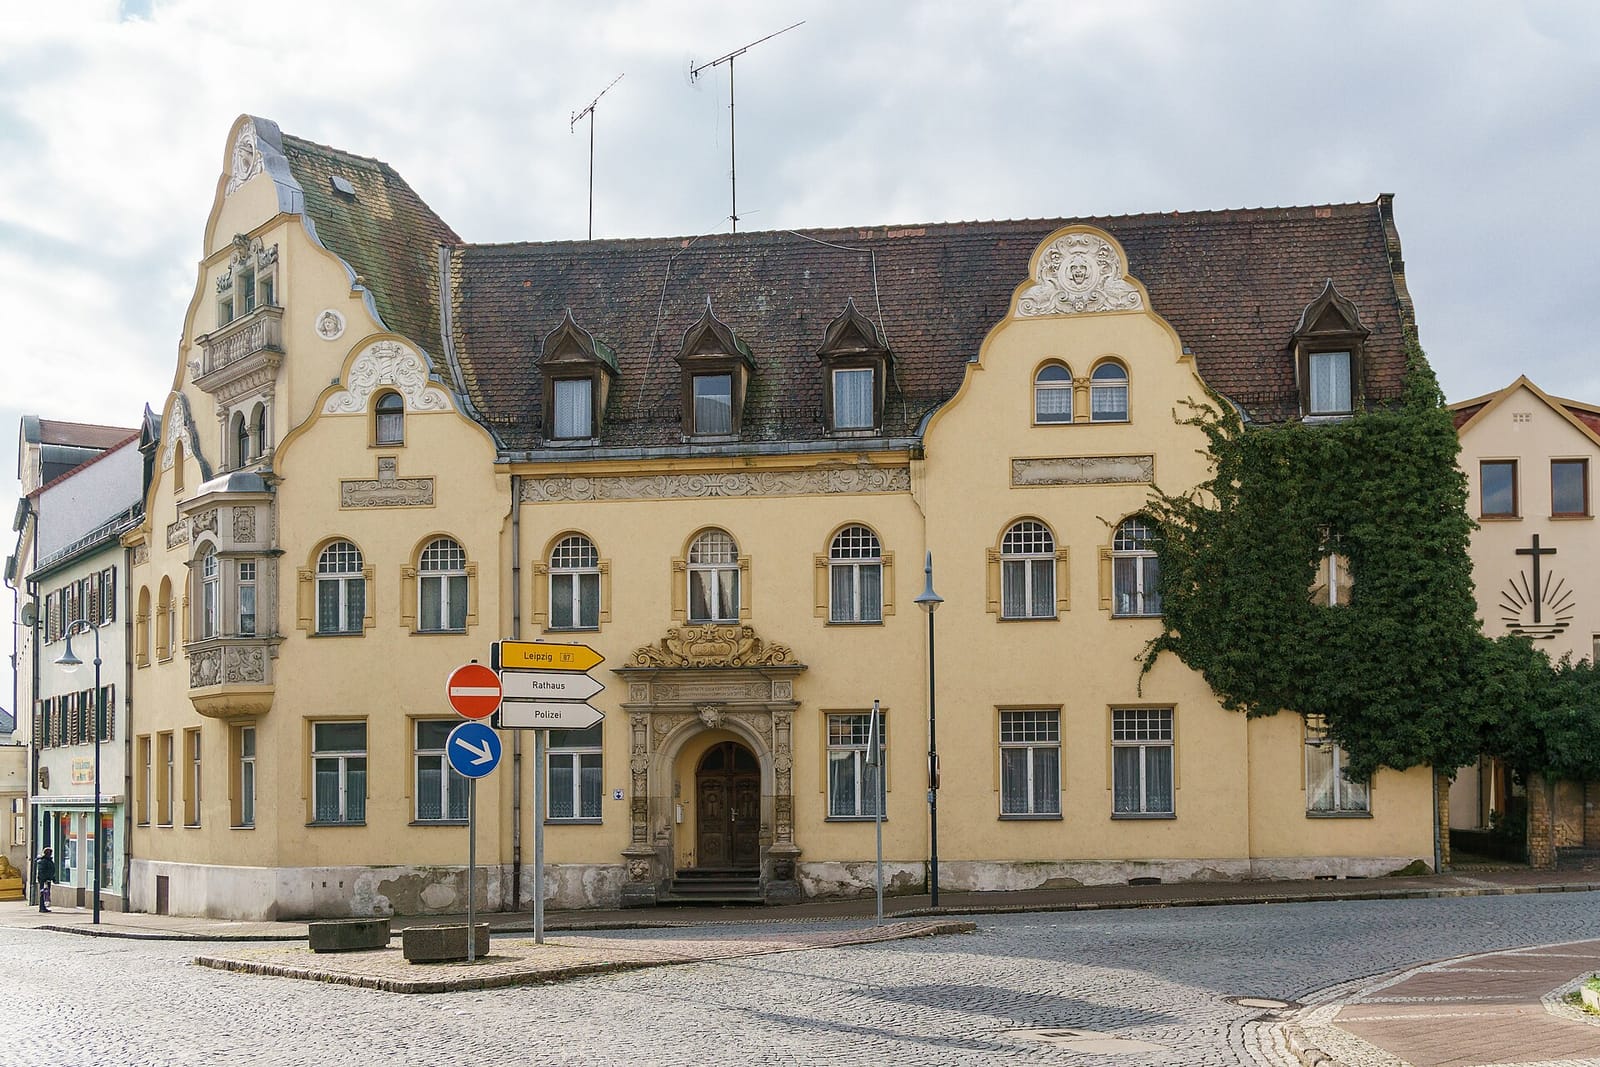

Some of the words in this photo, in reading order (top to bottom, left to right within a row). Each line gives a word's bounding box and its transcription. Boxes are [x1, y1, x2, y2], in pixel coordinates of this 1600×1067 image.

[524, 652, 553, 662] Leipzig
[532, 681, 566, 690] Rathaus
[535, 710, 562, 719] Polizei
